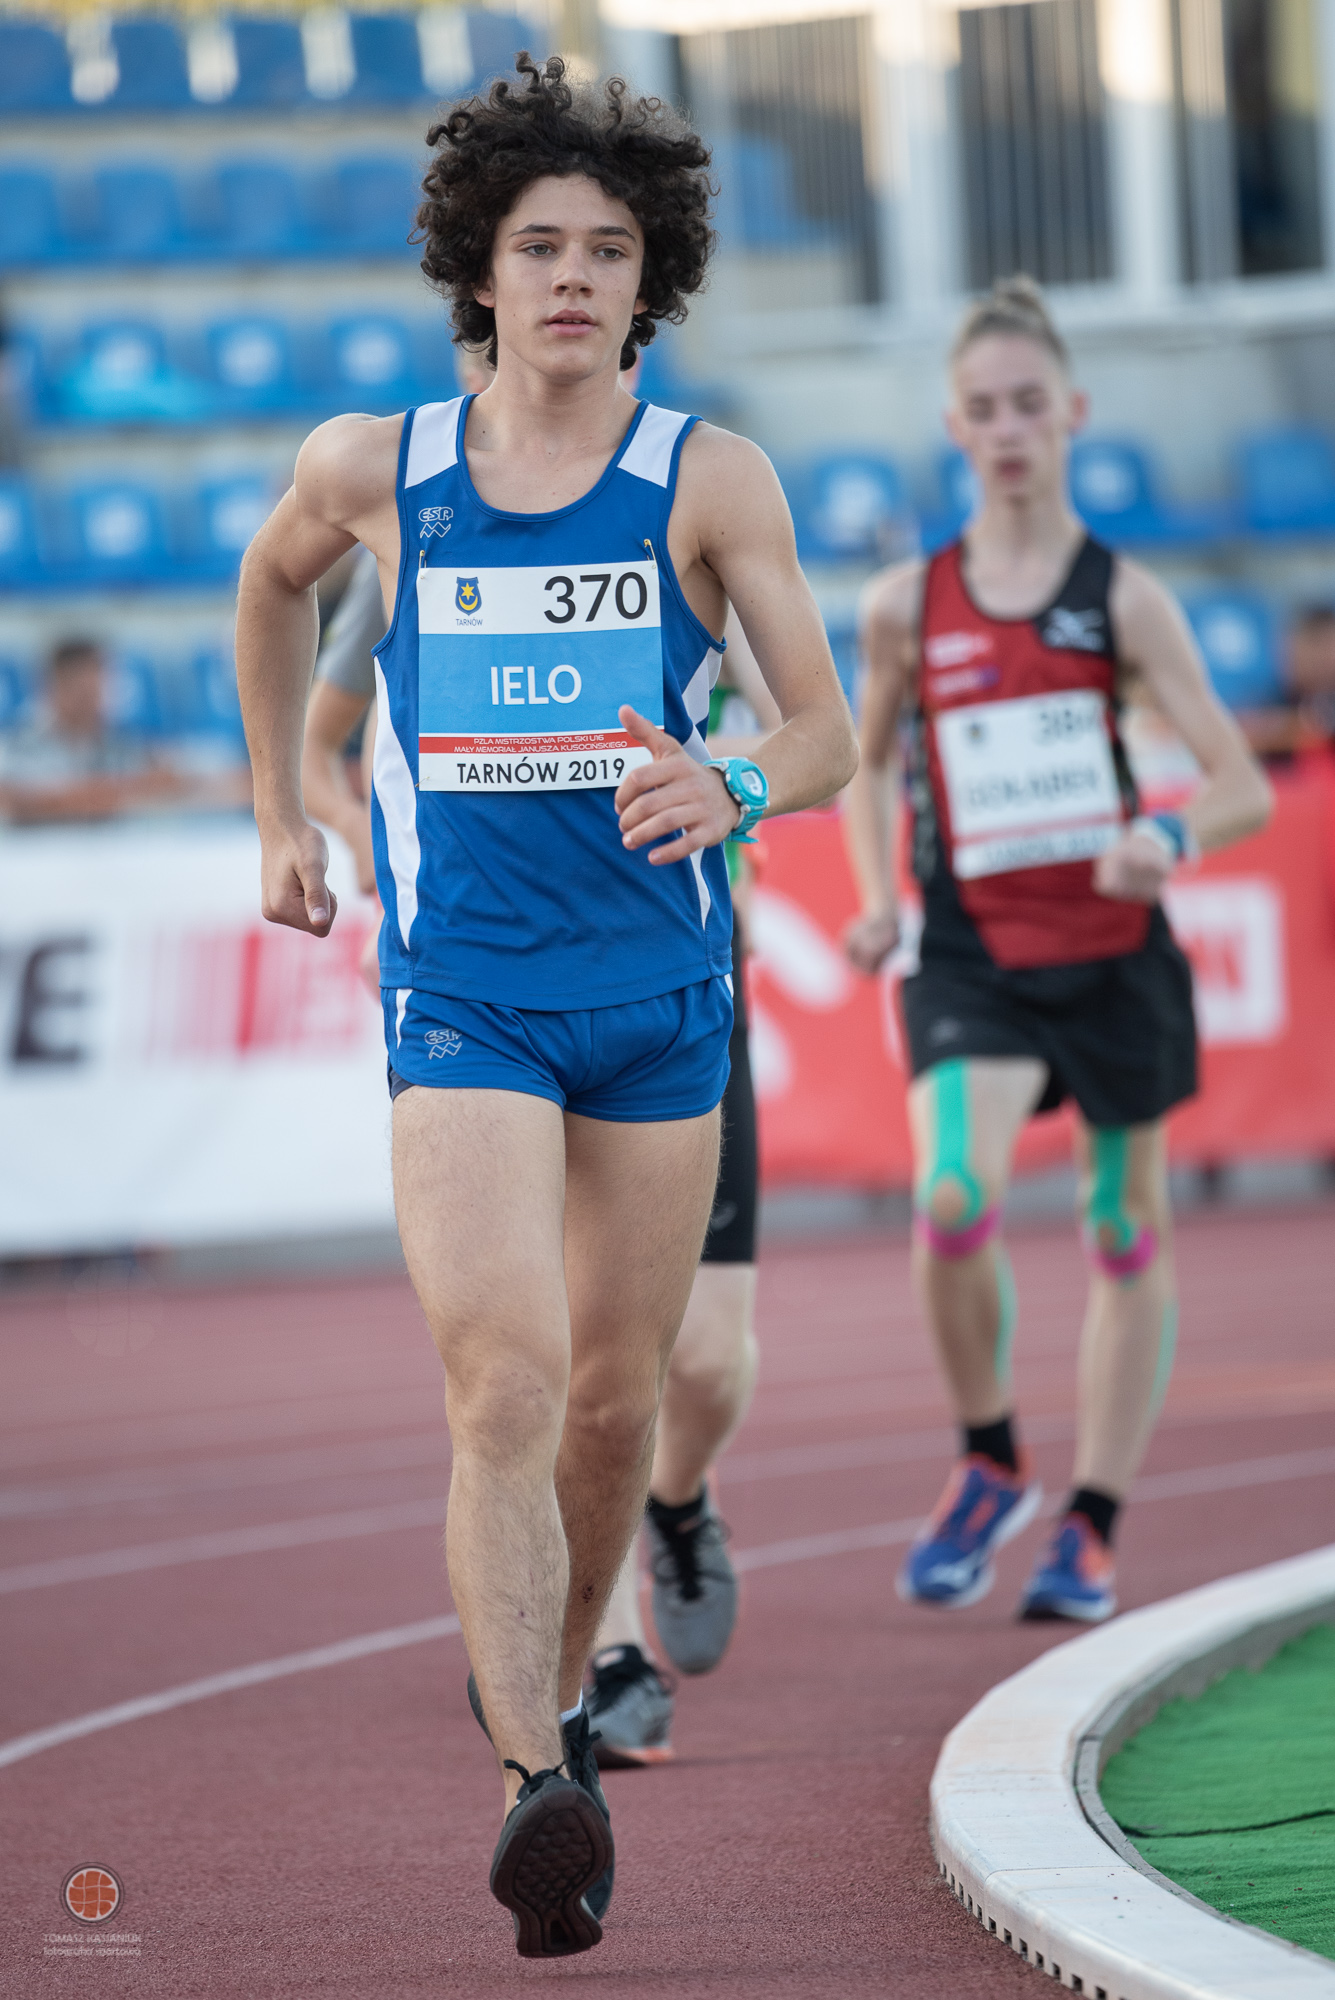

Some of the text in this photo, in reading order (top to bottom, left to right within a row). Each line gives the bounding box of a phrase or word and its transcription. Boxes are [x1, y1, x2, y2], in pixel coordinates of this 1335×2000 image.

[543, 571, 648, 624] 370
[455, 617, 483, 627] TARNÓW
[490, 664, 582, 706] IELO
[475, 746, 517, 754] MEMORIAŁ
[517, 744, 560, 753] JANUSZA
[494, 736, 557, 746] MISTRZOSTWA
[557, 735, 589, 744] POLSKI
[589, 734, 605, 742] U16
[456, 756, 625, 784] TARNÓW 2019
